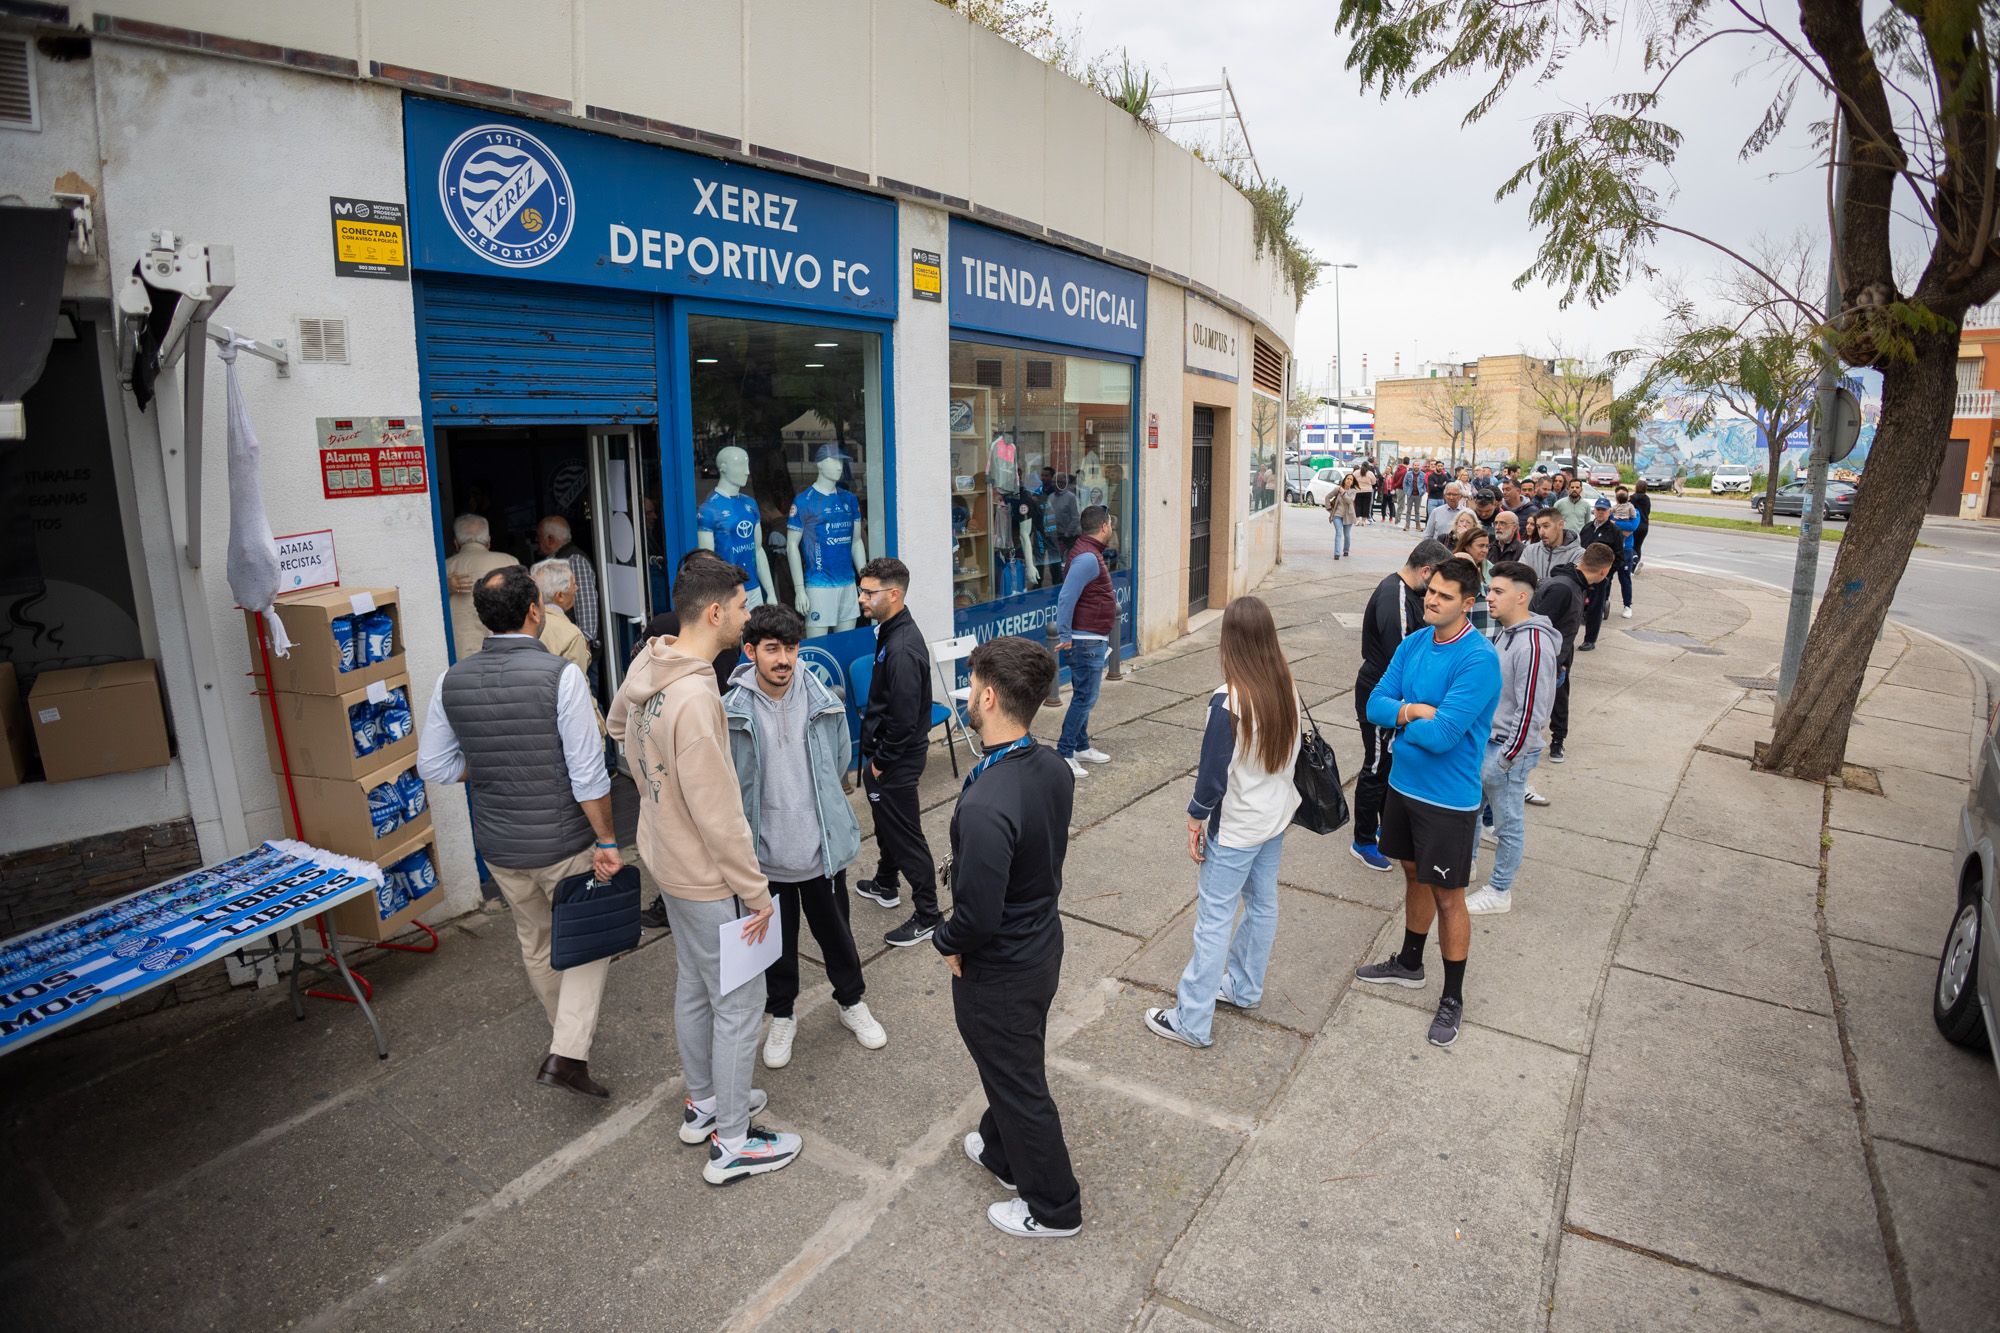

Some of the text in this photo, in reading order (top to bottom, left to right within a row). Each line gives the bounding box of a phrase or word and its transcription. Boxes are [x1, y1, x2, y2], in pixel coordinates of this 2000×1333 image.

[486, 134, 522, 148] 1911
[449, 186, 457, 196] F
[482, 165, 536, 232] XEREZ
[558, 196, 567, 206] C
[693, 178, 798, 233] XEREZ
[341, 226, 399, 239] CONECTADA
[467, 228, 558, 259] DEPORTIVO
[609, 223, 871, 296] DEPORTIVO FC
[961, 256, 1138, 330] TIENDA OFICIAL
[1193, 322, 1236, 357] OLIMPUS 2
[325, 451, 370, 464] Alarma
[378, 448, 422, 461] Alarma
[25, 468, 91, 485] TURALES
[29, 492, 88, 507] EGANAS
[279, 540, 314, 556] ATATAS
[280, 554, 322, 571] RECISTAS
[193, 867, 326, 924] LIBRES
[221, 874, 357, 935] LIBRES
